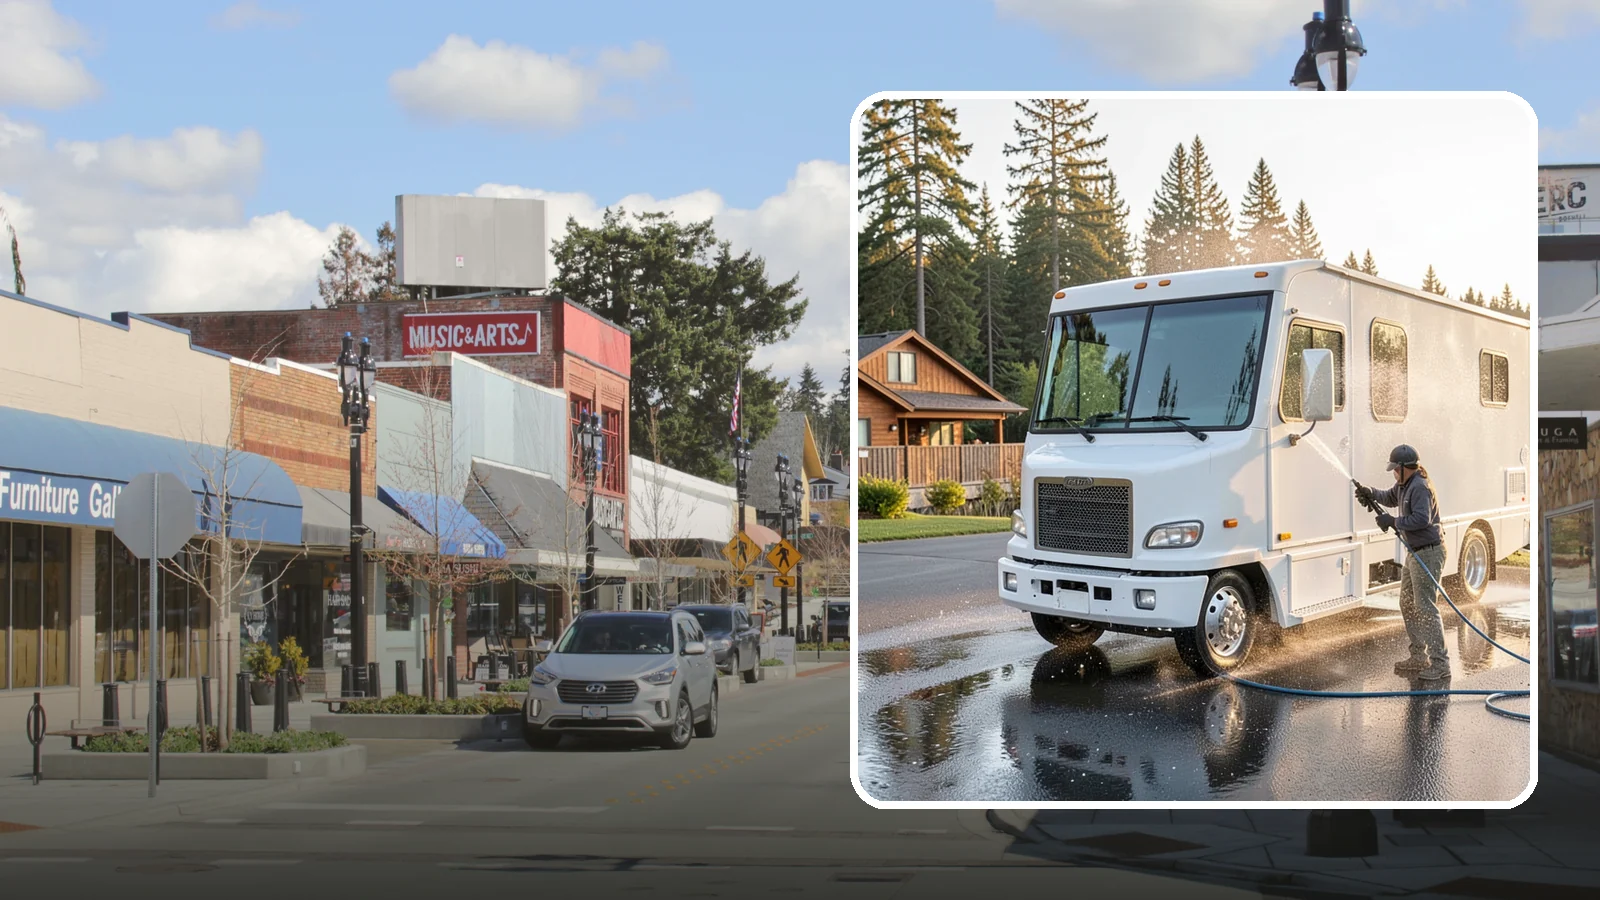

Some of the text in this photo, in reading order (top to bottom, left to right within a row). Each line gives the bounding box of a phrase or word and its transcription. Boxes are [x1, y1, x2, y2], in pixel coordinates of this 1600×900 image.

[1538, 181, 1586, 213] ERC
[408, 323, 519, 348] MUSIC&ARTS
[0, 471, 121, 519] Furniture Gal
[453, 562, 480, 574] SUSHI
